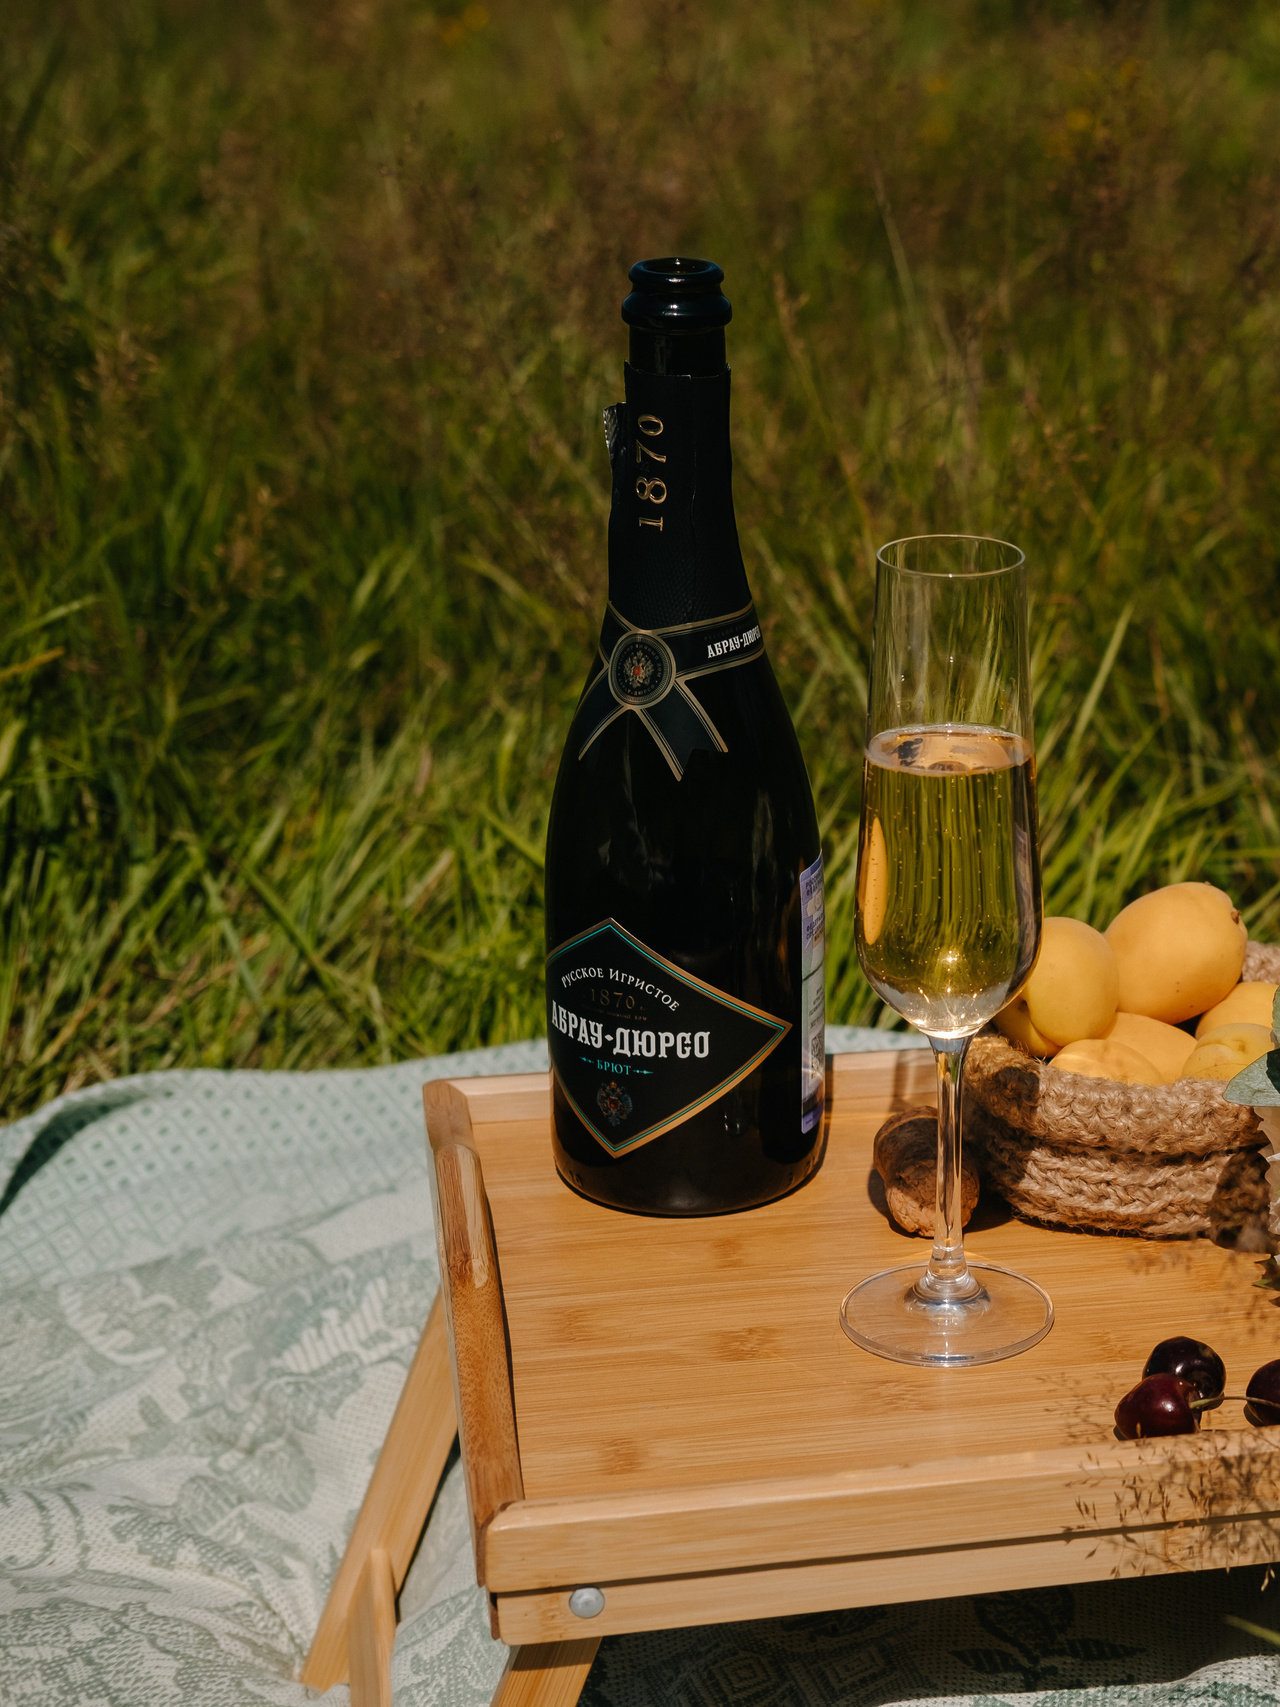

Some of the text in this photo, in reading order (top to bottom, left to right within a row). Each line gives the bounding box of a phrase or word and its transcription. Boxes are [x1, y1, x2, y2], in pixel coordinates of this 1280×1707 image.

[636, 413, 668, 532] 1870
[561, 967, 604, 988] РУССКОЕ
[609, 968, 680, 1012] ИГРИСТОЕ
[591, 988, 635, 1010] 1870
[596, 1059, 632, 1076] БРЮТ
